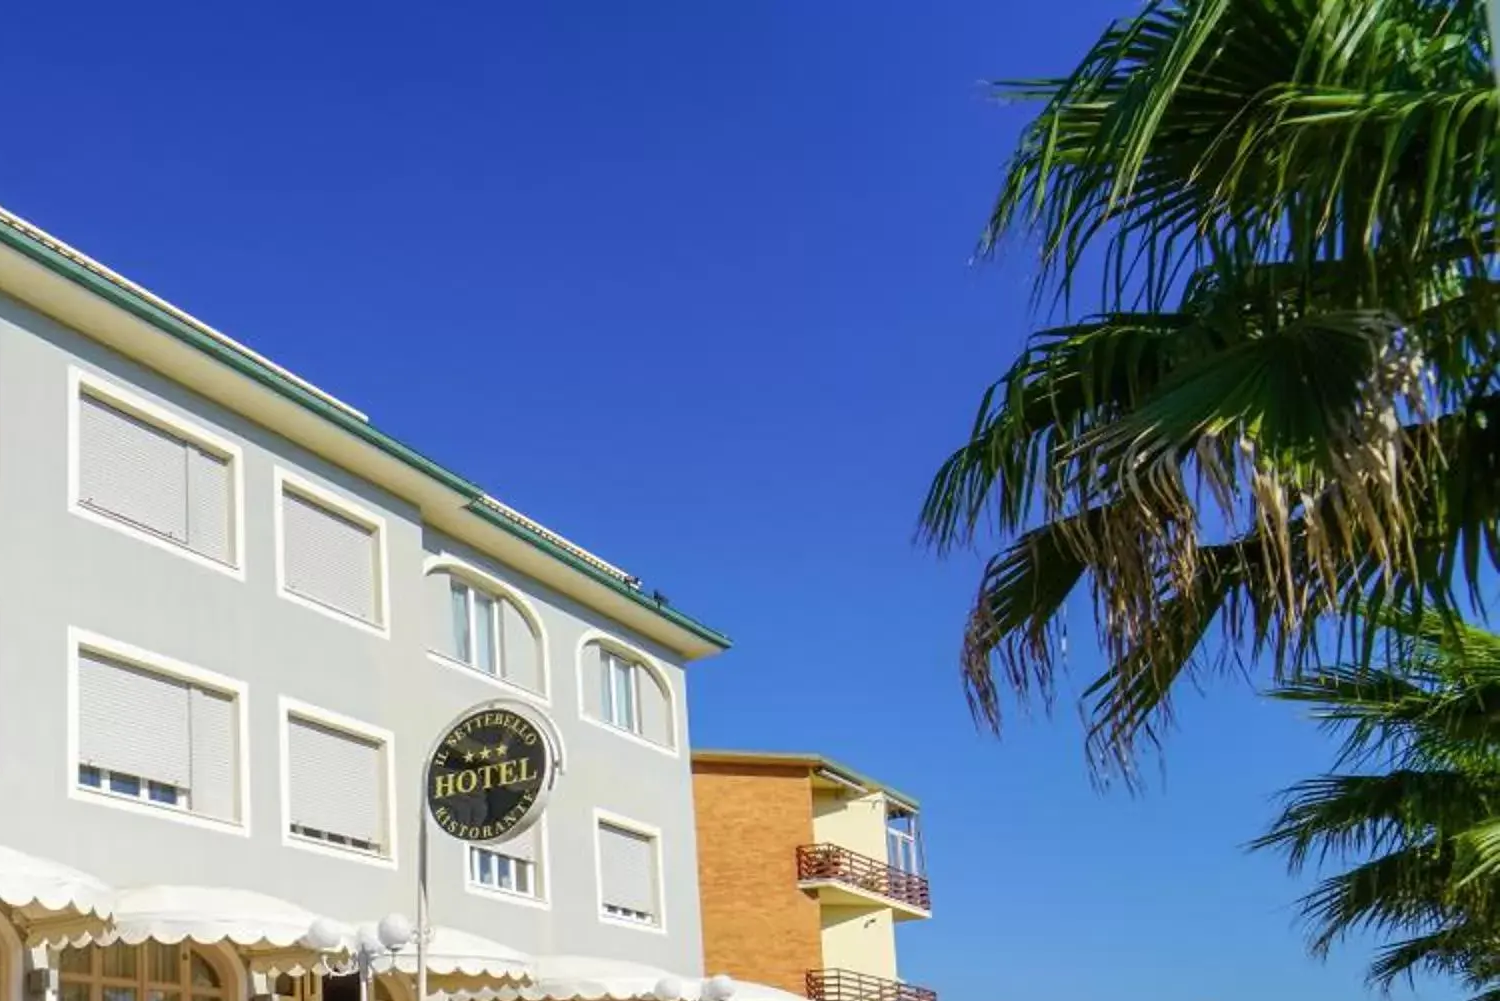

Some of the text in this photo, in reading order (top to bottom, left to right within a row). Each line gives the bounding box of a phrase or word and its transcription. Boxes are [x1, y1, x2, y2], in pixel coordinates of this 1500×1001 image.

[434, 713, 537, 768] IL SETTEBELLO
[433, 757, 537, 800] HOTEL
[435, 788, 535, 839] RISTORANTE
